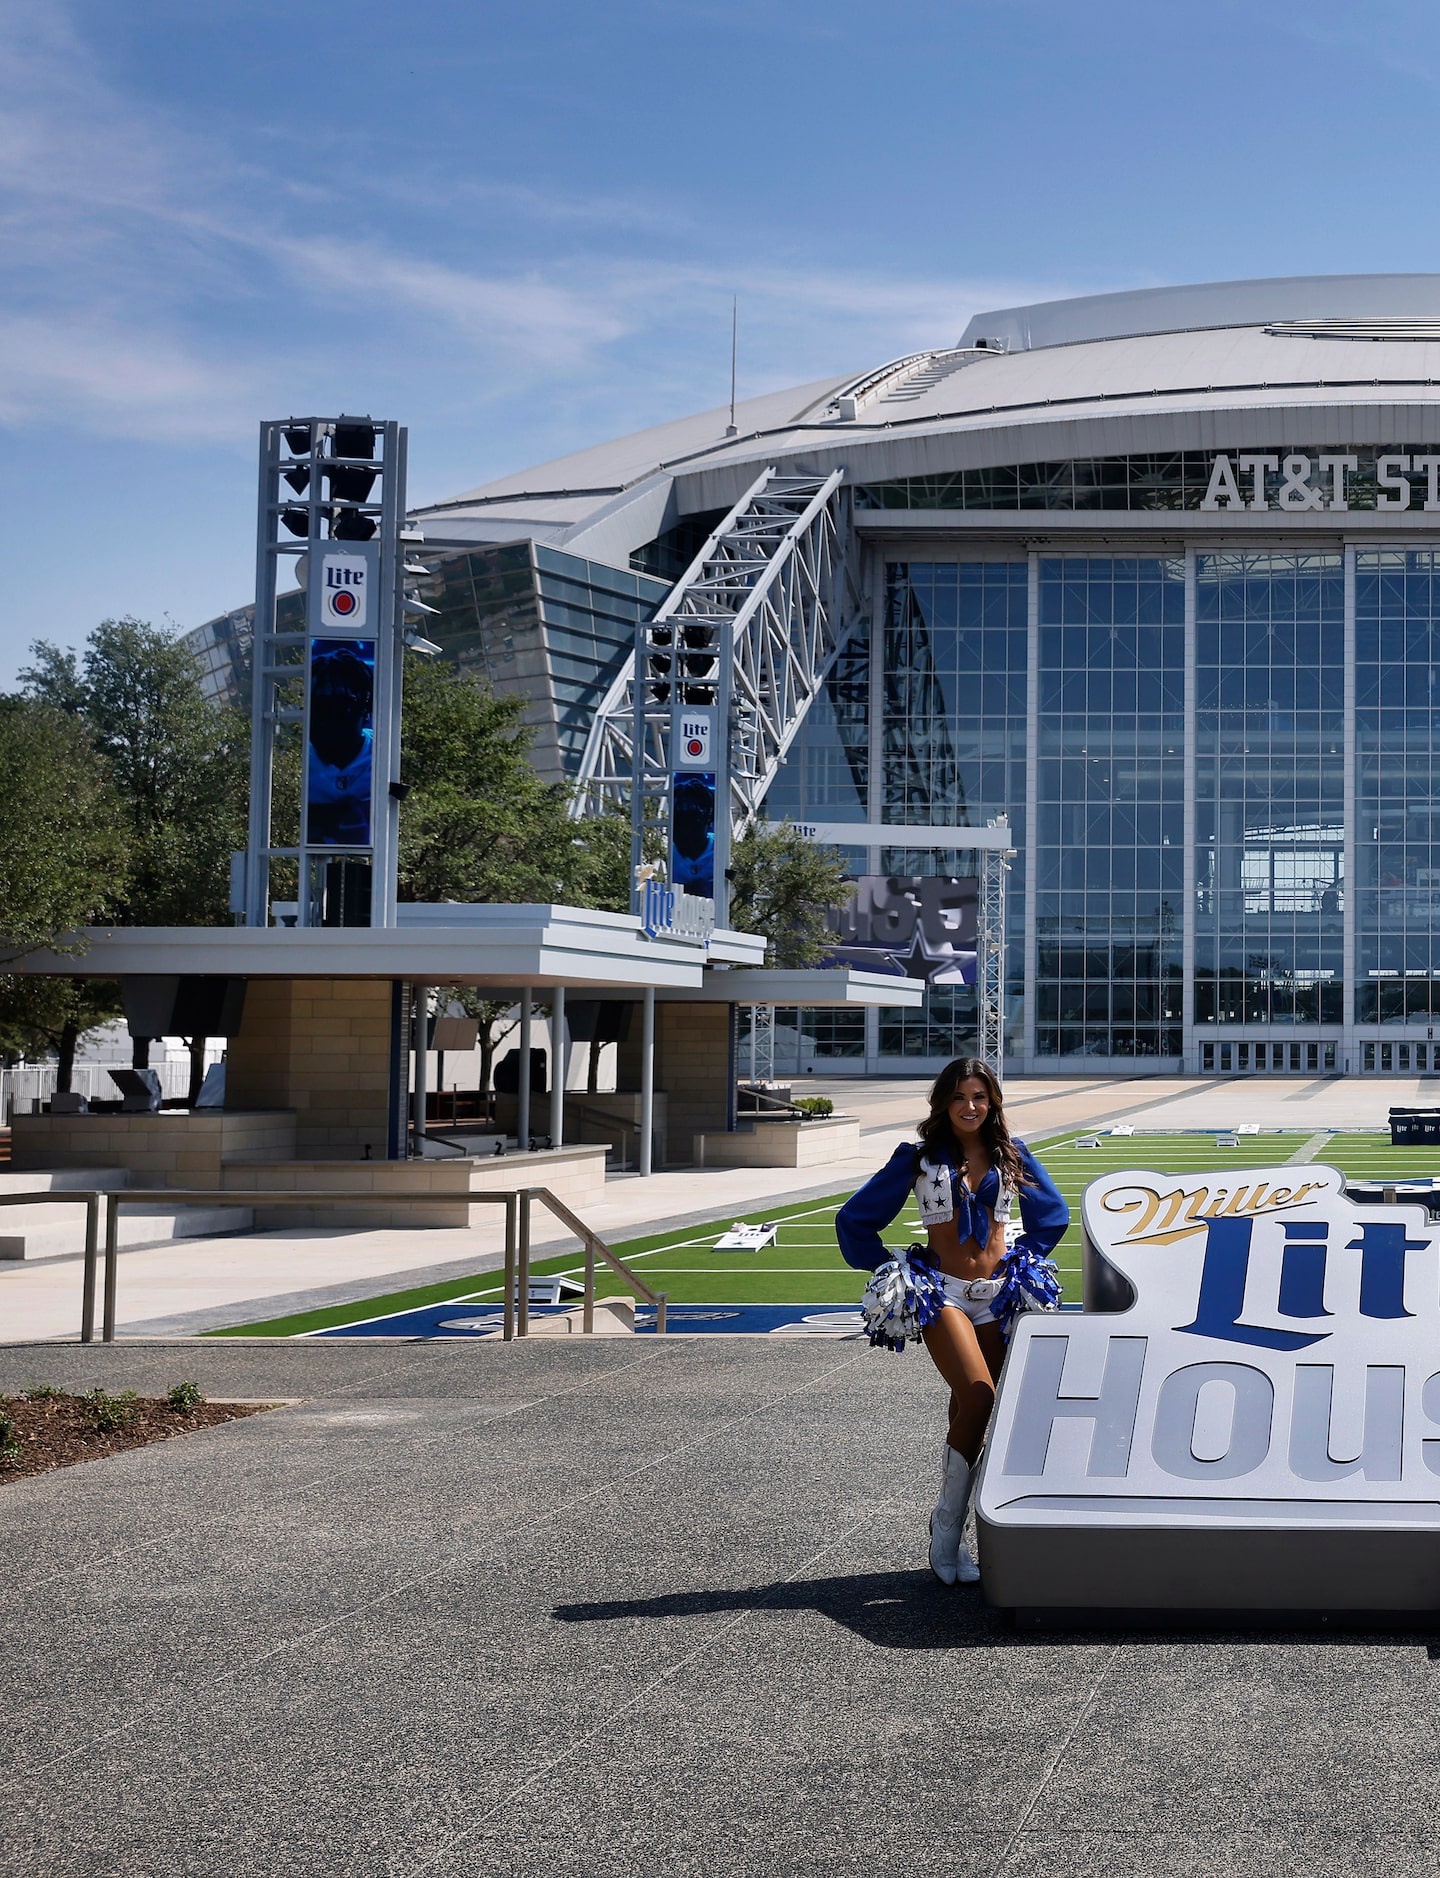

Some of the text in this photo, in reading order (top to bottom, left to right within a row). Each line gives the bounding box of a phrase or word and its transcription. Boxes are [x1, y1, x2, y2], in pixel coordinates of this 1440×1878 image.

[1199, 454, 1358, 512] AT&T
[326, 567, 364, 589] Lite
[683, 723, 708, 739] Lite
[1427, 1027, 1434, 1040] H
[1101, 1182, 1330, 1238] Miller
